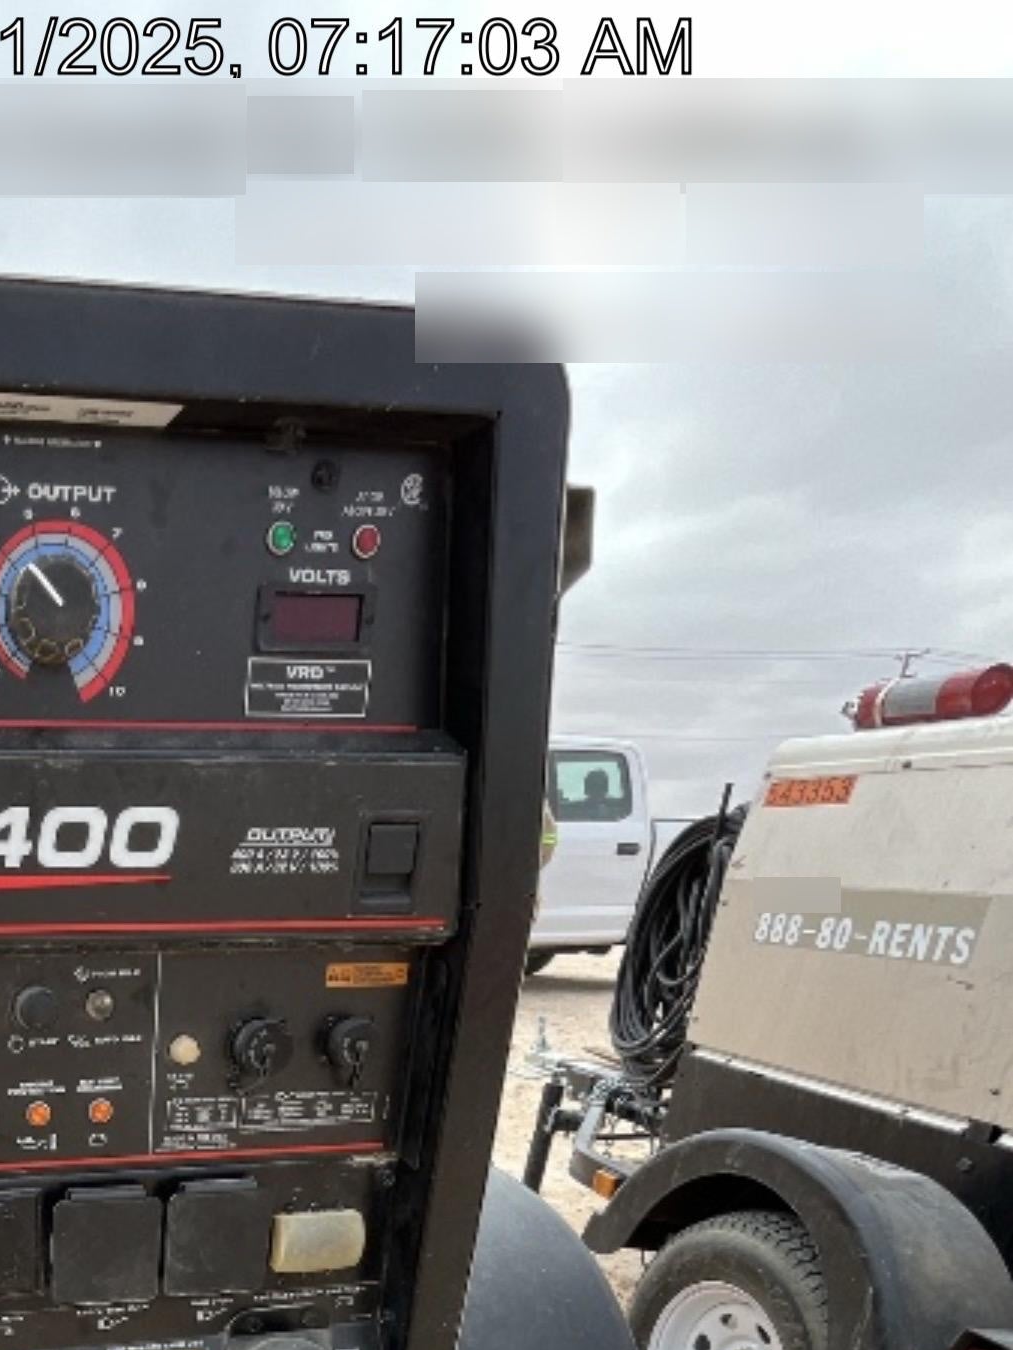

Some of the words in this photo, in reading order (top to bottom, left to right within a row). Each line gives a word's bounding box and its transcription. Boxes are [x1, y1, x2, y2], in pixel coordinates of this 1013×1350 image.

[27, 483, 117, 502] OUTPUT
[289, 567, 351, 586] VOLTS
[754, 912, 975, 964] 888-80-RENTS
